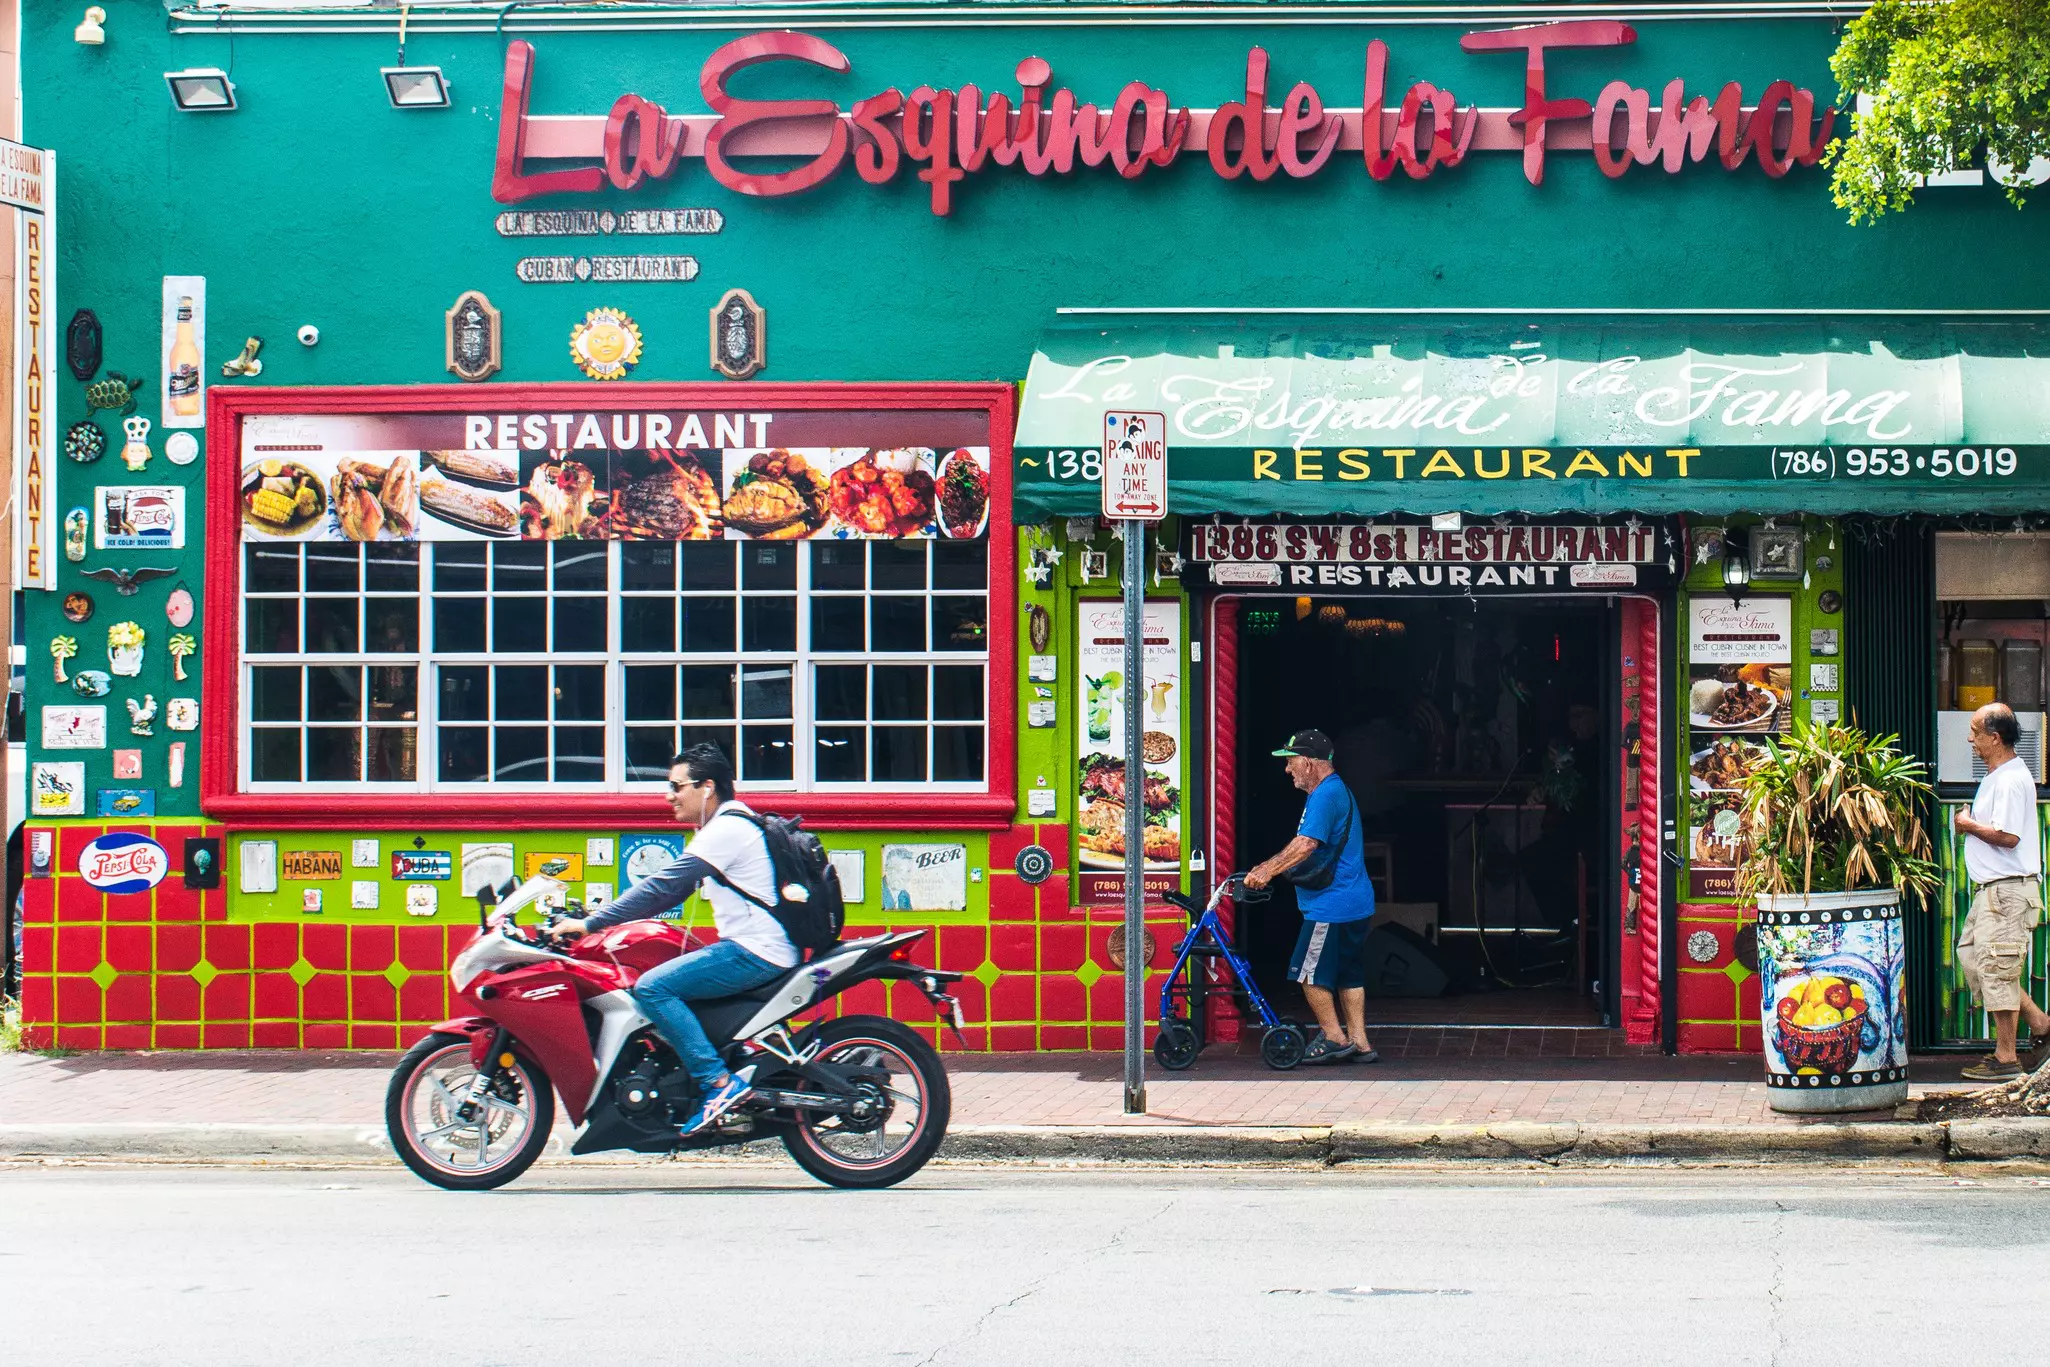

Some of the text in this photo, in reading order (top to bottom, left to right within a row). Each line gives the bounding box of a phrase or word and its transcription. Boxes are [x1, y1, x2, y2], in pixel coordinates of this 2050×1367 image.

[491, 40, 689, 204] La
[701, 30, 1191, 217] Esquina
[1206, 46, 1344, 182] de
[1363, 38, 1478, 182] la
[1459, 20, 1836, 187] Fama
[9, 147, 42, 177] ESQUINA
[9, 175, 18, 199] LA
[21, 178, 42, 205] FAMA
[504, 209, 716, 232] LA ESQUINA DE LA FAMA
[524, 260, 690, 280] CUBAN RESTAURANT
[26, 219, 42, 580] RESTAURANTE
[1038, 355, 1138, 403] La
[1161, 373, 1511, 451] Esquina
[1634, 361, 1913, 440] Fama
[465, 413, 773, 449] RESTAURANT
[1108, 439, 1162, 460] PING
[1045, 450, 1102, 481] 138
[1253, 448, 1701, 481] RESTAURANT
[1771, 447, 1836, 481] (786)
[1123, 463, 1147, 476] ANY
[1121, 478, 1148, 492] TIME
[1192, 525, 1278, 561] 1388
[1285, 525, 1343, 561] SW
[1418, 526, 1652, 562] RESTAURANT
[1290, 564, 1560, 586] RESTAURANT
[1083, 647, 1098, 655] BEST
[1157, 647, 1177, 655] TOWN
[1693, 643, 1708, 651] BEST
[1711, 643, 1733, 651] CUBAN
[1768, 643, 1788, 651] TOWN
[283, 858, 341, 875] HABANA
[402, 858, 440, 873] CUBA
[915, 848, 962, 869] BEER
[1094, 881, 1121, 890] (786)
[1704, 879, 1732, 889] (786)
